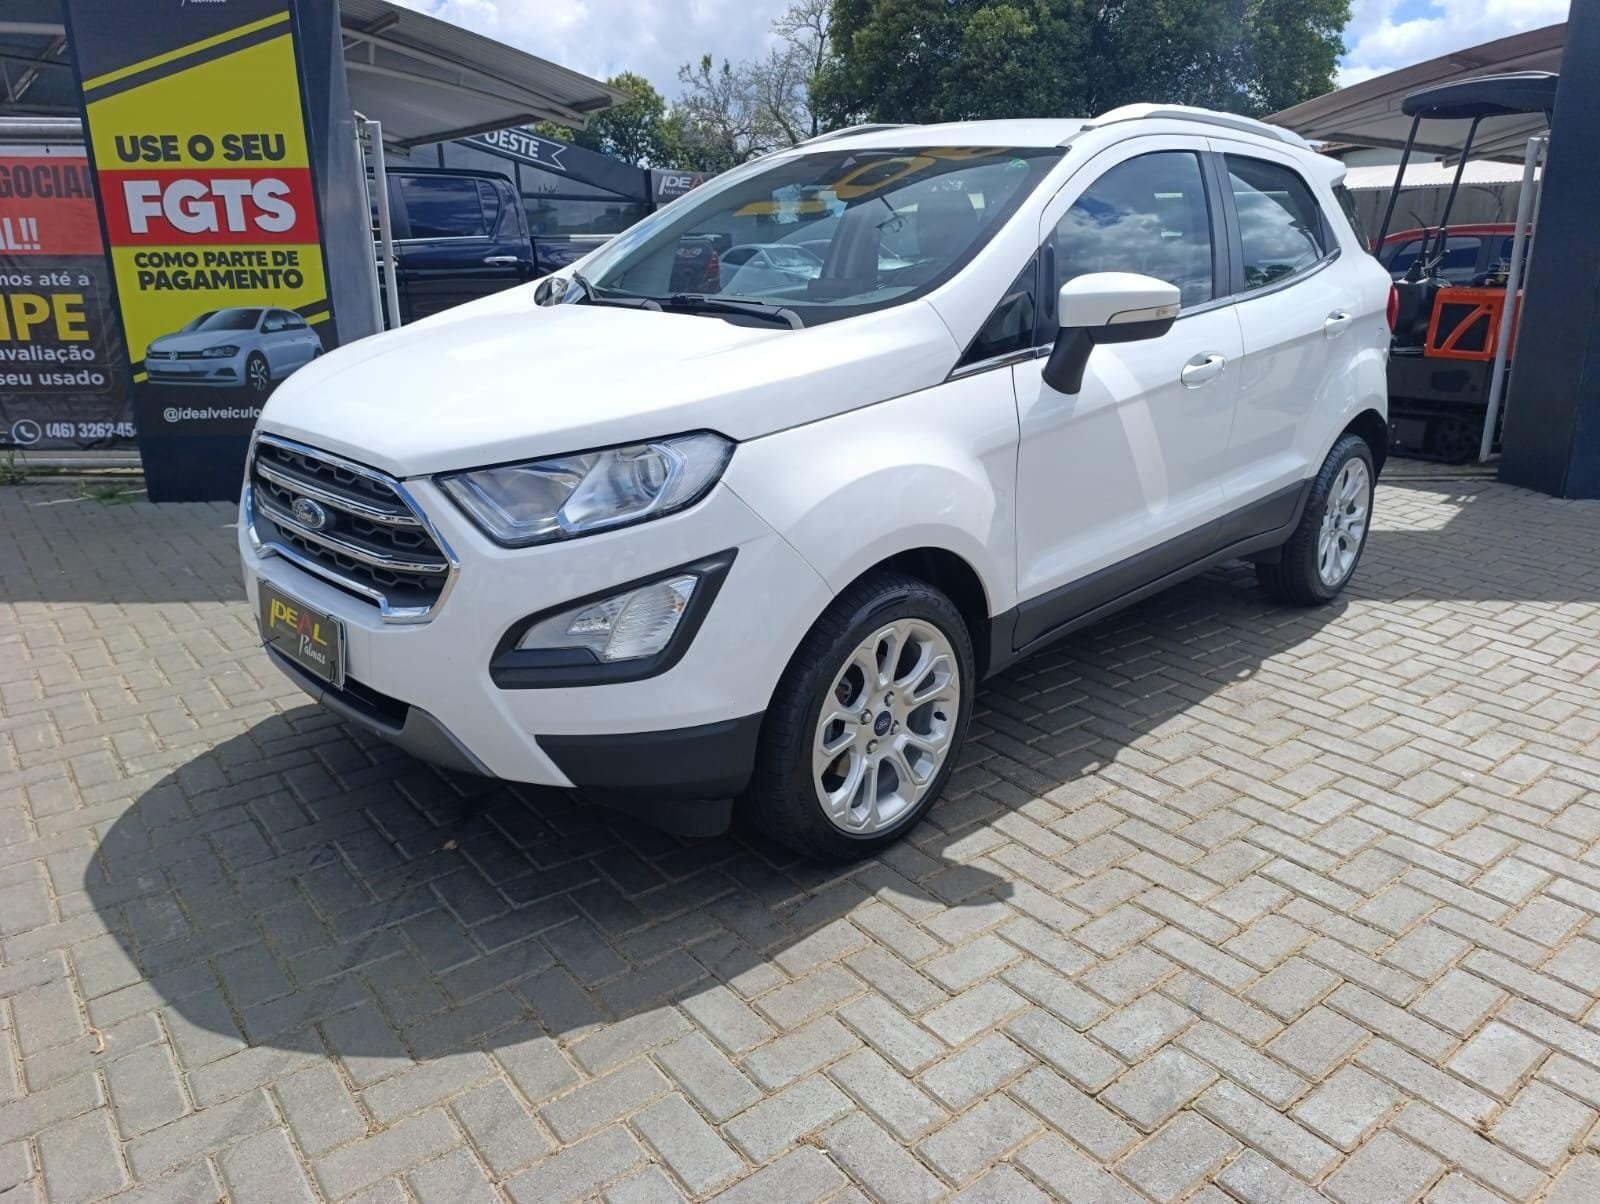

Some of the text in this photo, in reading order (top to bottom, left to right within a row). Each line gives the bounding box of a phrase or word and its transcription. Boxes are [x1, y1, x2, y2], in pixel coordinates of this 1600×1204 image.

[114, 133, 286, 162] USE O SEU
[122, 178, 297, 234] FGTS
[134, 250, 299, 269] COMO PARTE DE
[39, 271, 72, 286] até
[78, 274, 90, 286] a
[137, 268, 304, 291] PAGAMENTO
[39, 370, 105, 386] usado
[46, 422, 137, 438] (46) 3262-45
[270, 598, 328, 646] IDEAL
